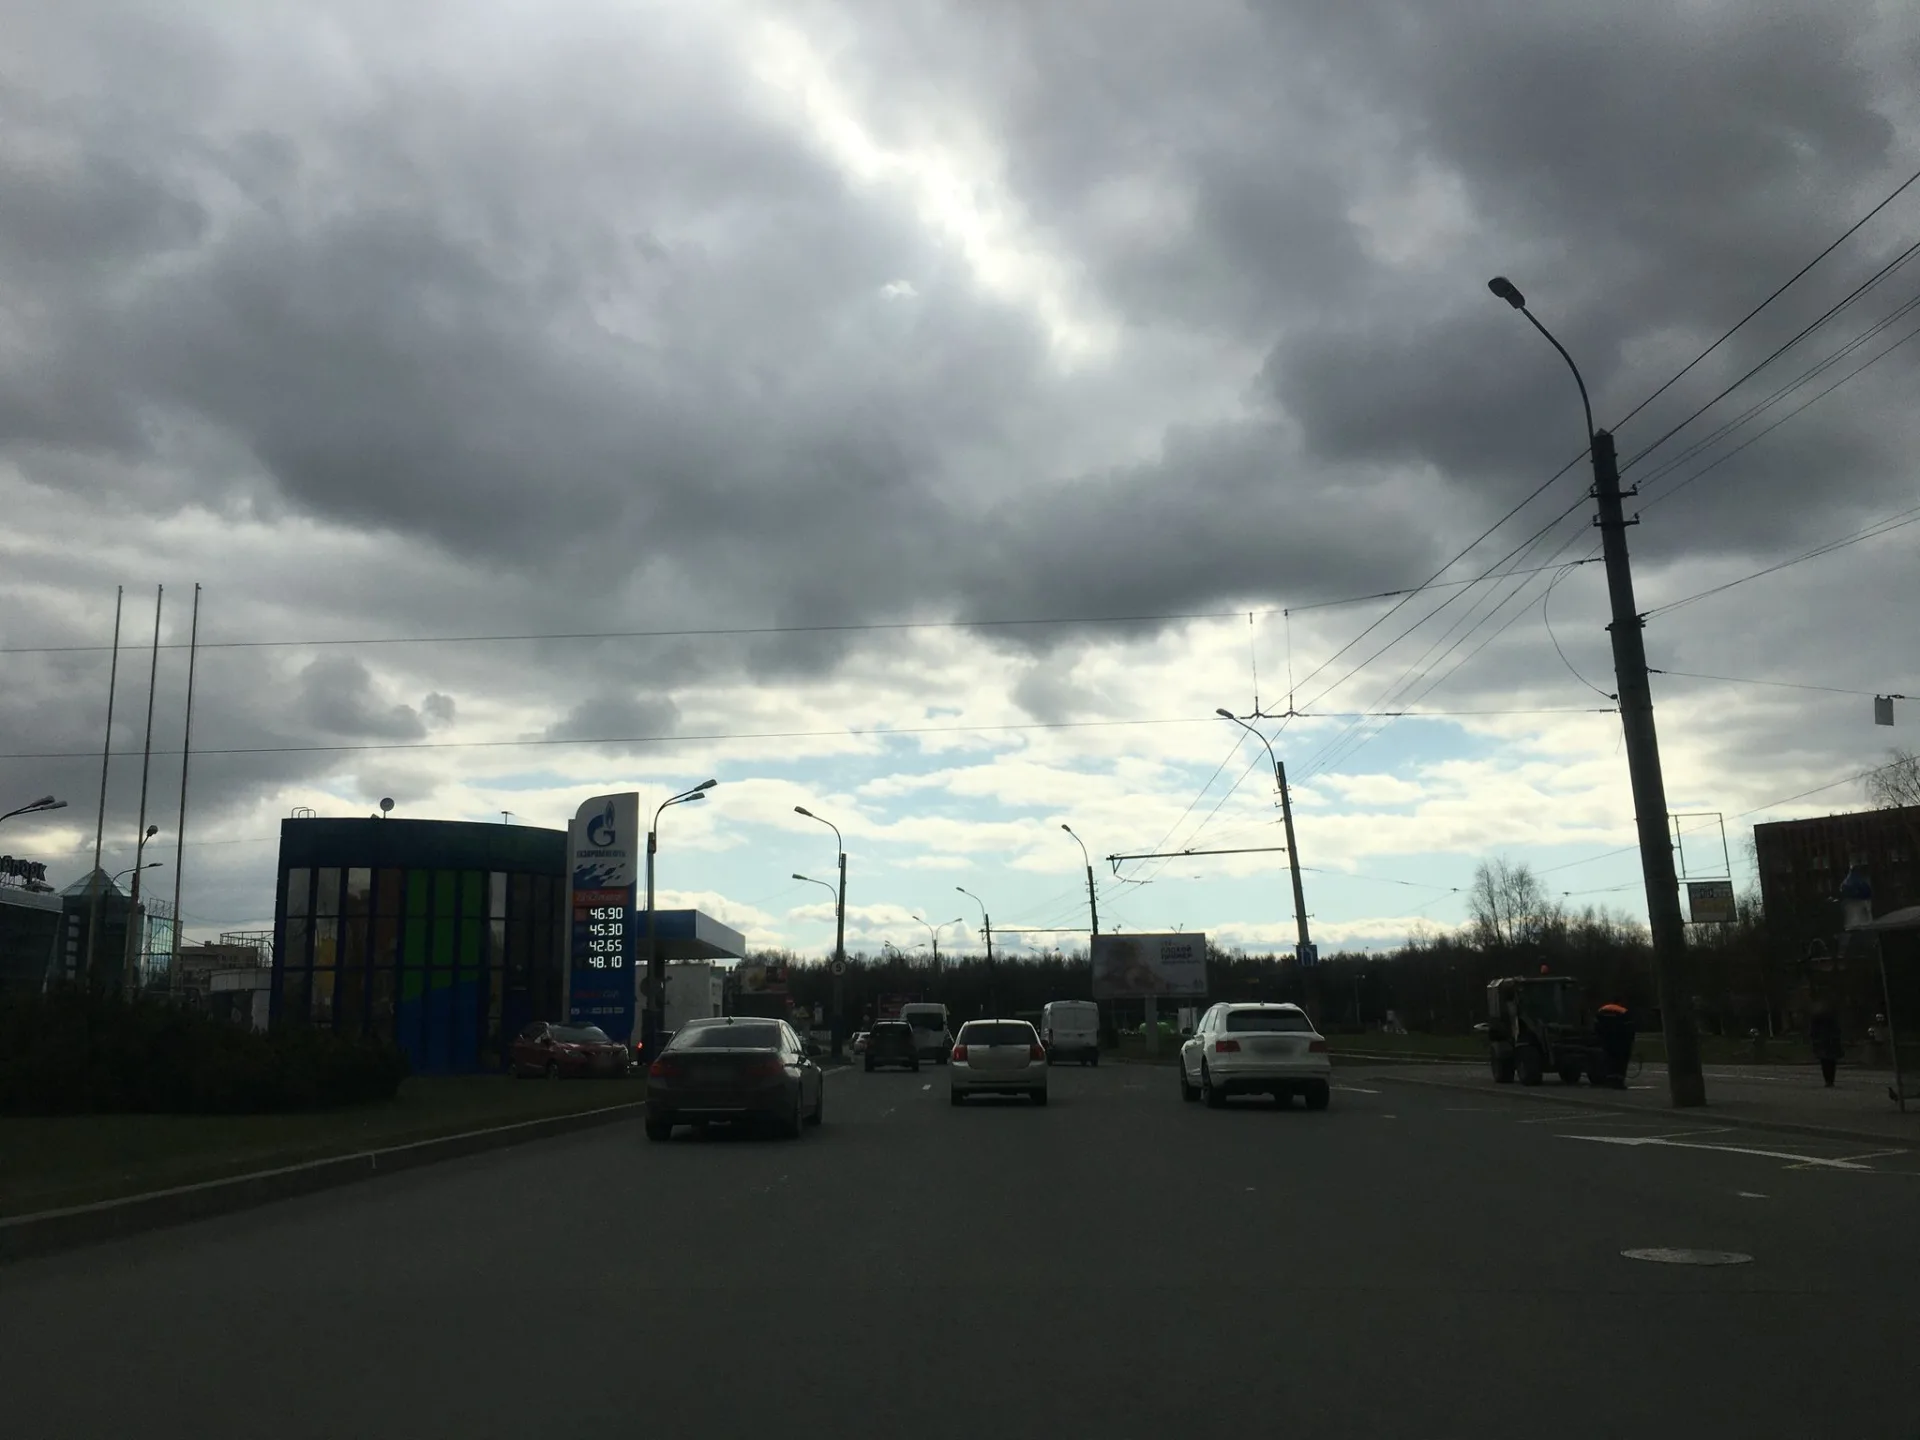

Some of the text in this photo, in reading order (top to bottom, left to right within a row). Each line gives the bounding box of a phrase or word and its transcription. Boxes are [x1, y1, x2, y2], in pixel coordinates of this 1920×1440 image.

[589, 907, 623, 920] 46.90
[589, 923, 623, 936] 45.30
[588, 939, 622, 952] 42.65
[588, 955, 622, 968] 48.10
